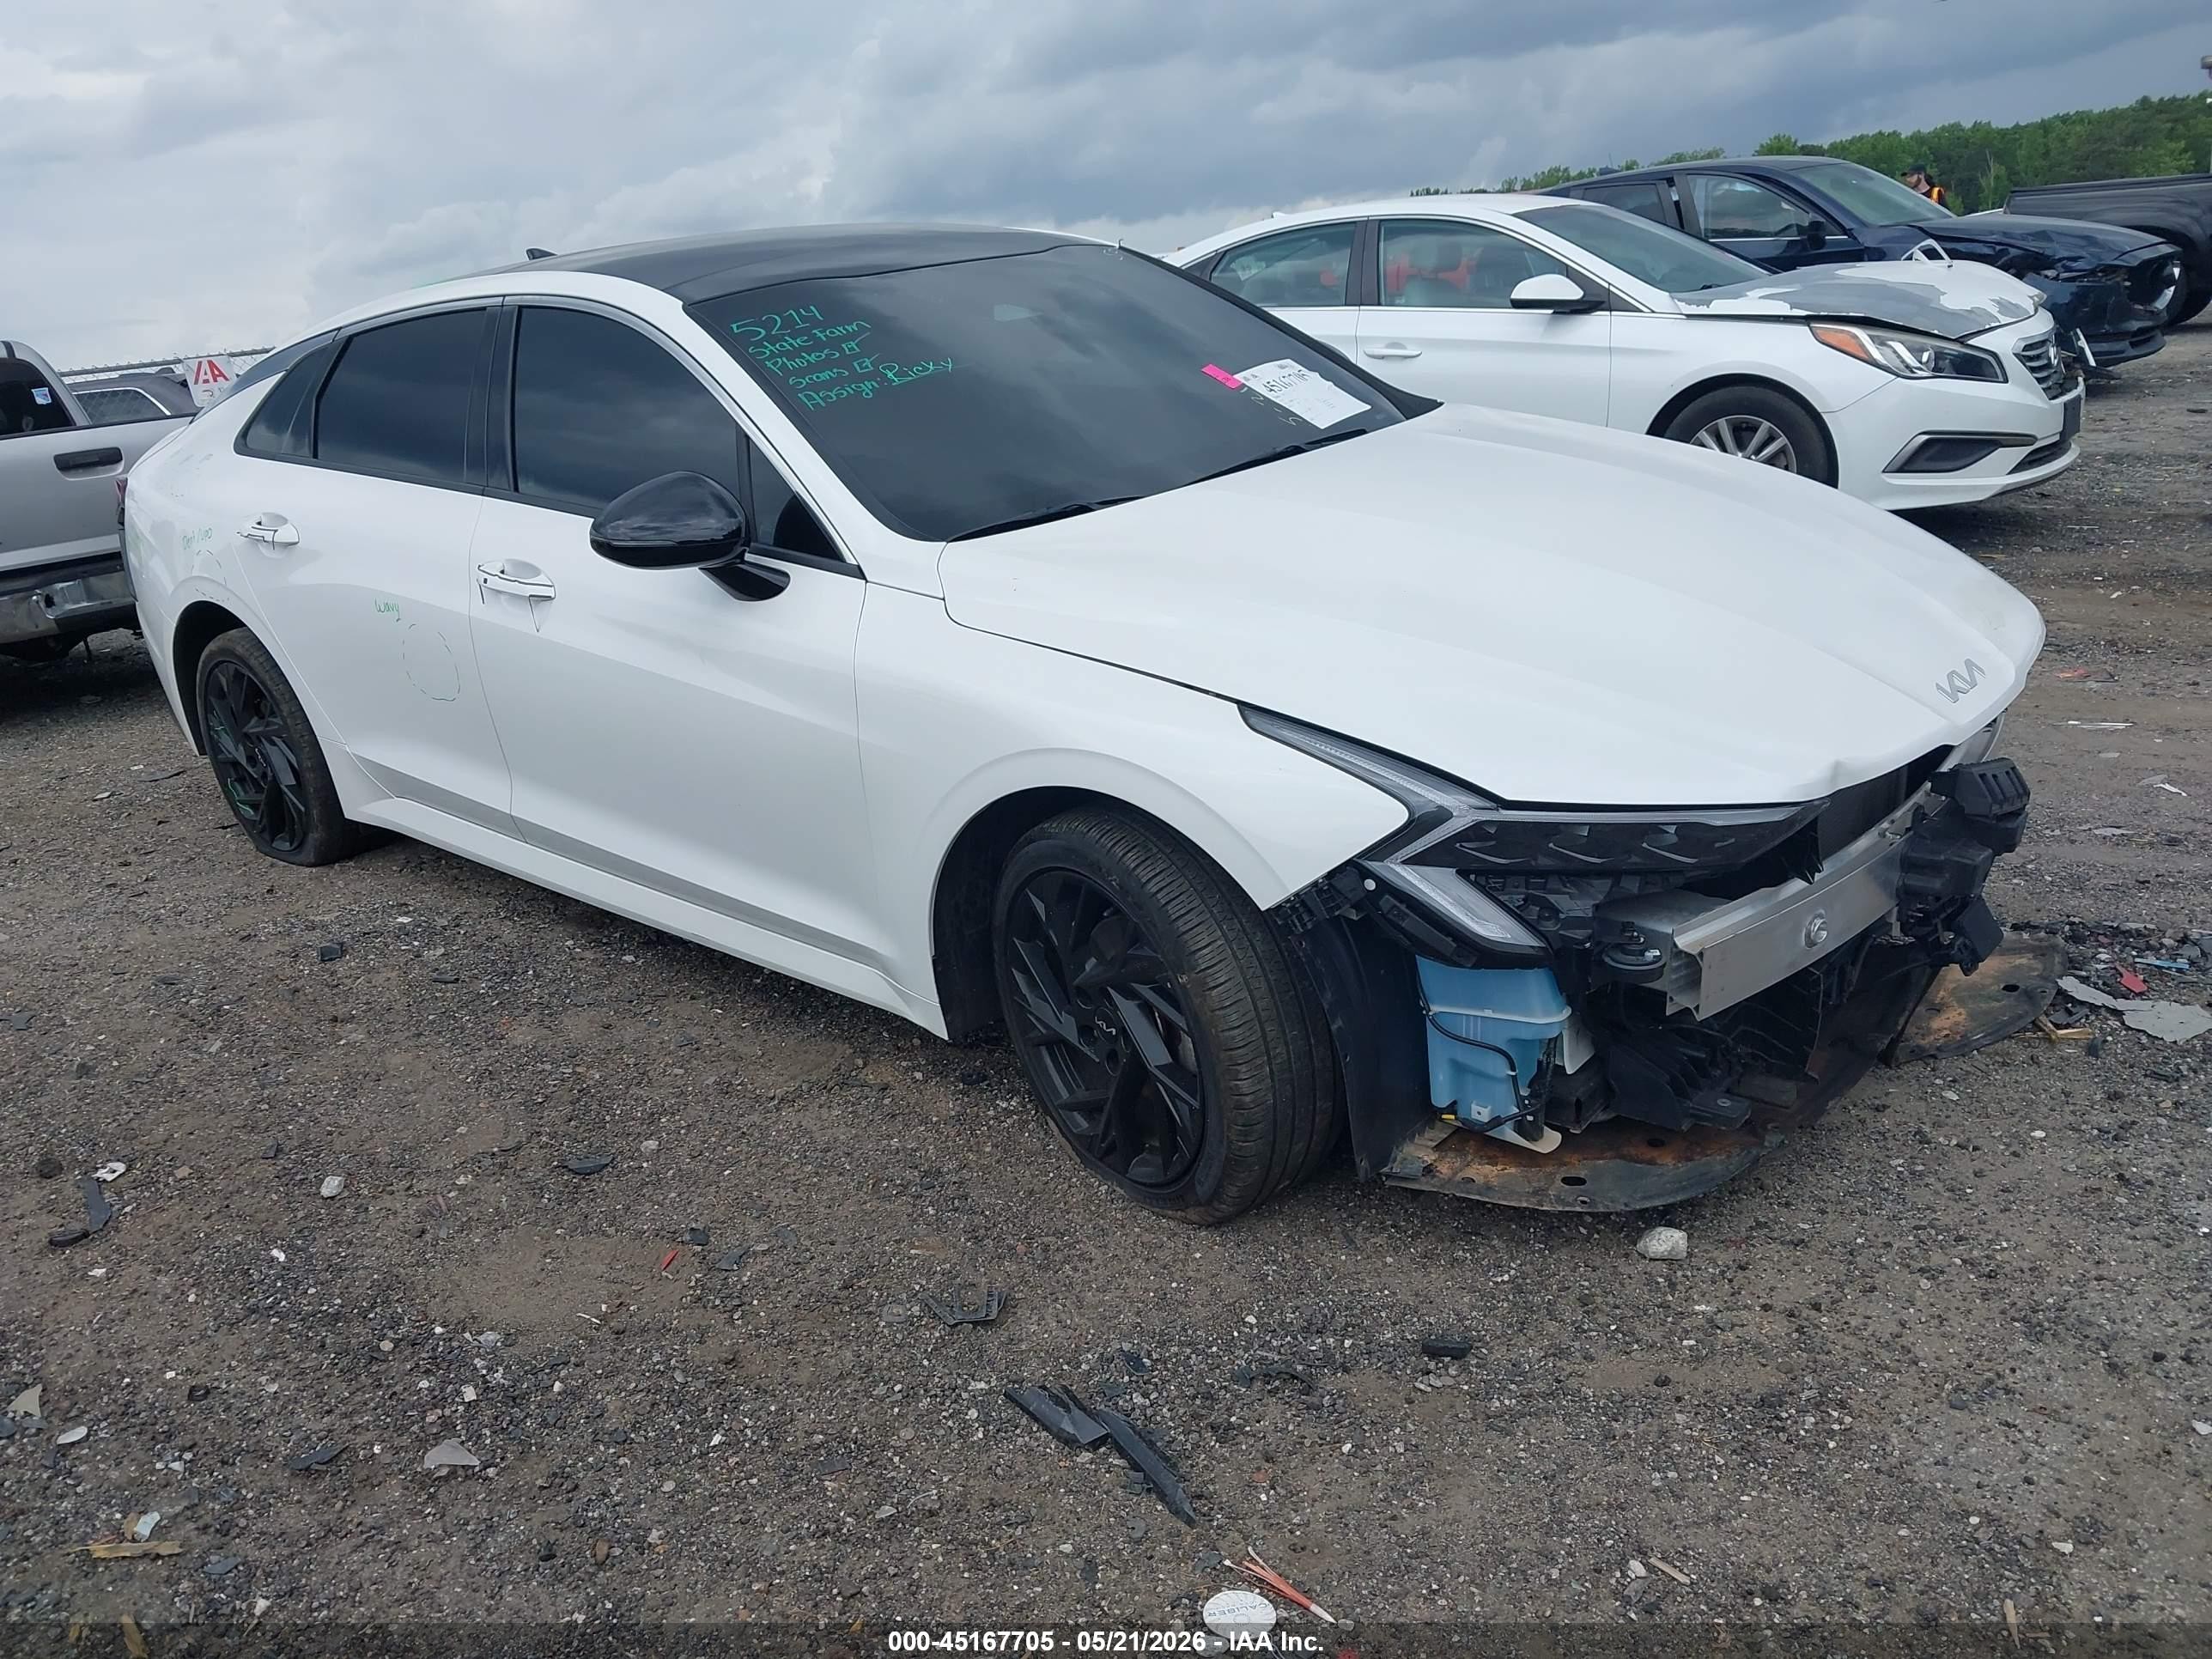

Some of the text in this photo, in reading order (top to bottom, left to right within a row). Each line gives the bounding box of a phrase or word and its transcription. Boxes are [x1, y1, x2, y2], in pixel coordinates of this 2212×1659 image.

[731, 305, 824, 342] 5214
[749, 320, 872, 359] State Farm
[765, 349, 840, 377] Photos
